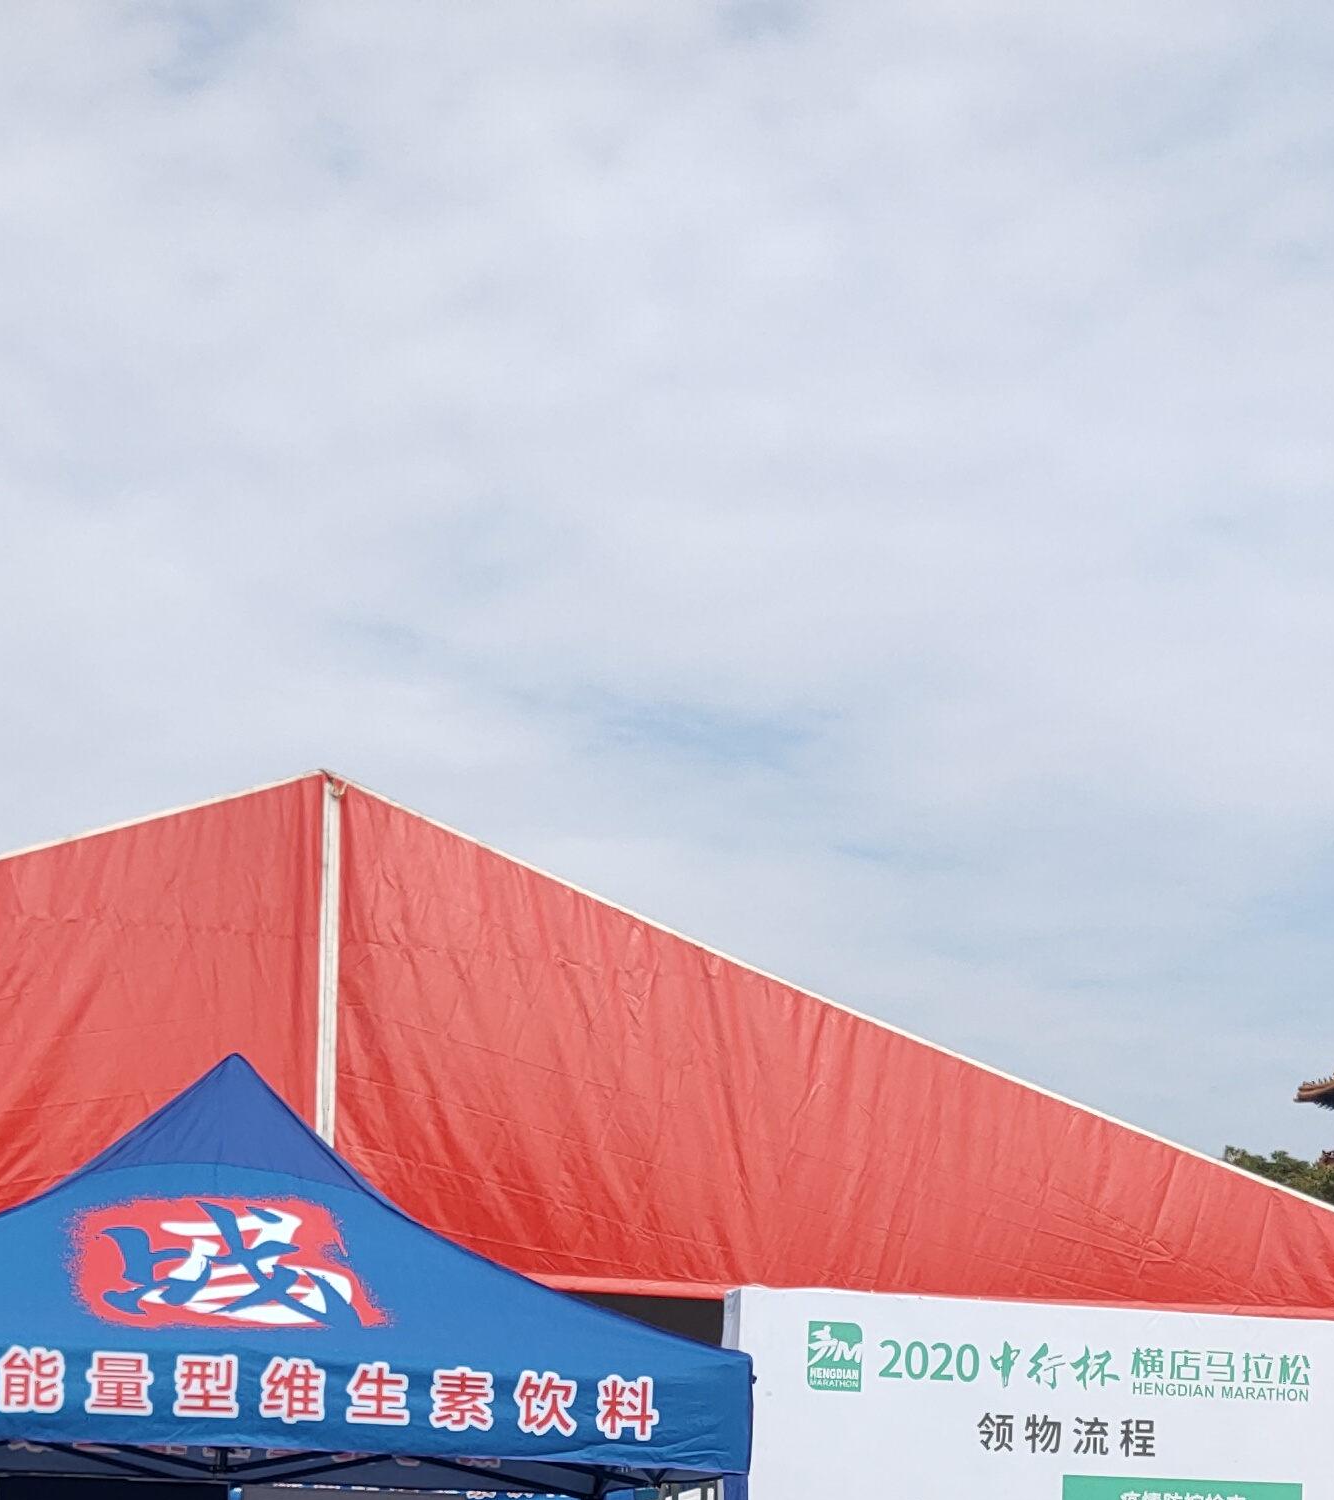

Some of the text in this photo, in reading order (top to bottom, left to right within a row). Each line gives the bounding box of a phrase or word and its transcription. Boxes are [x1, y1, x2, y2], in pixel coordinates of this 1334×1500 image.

[878, 1339, 980, 1383] 2020
[1130, 1347, 1311, 1386] 横店马拉松
[810, 1367, 859, 1380] HENGDIAN
[810, 1379, 859, 1389] MARATHON
[1132, 1382, 1310, 1402] HENGDIAN MARATHON
[976, 1412, 1156, 1458] 领物流程
